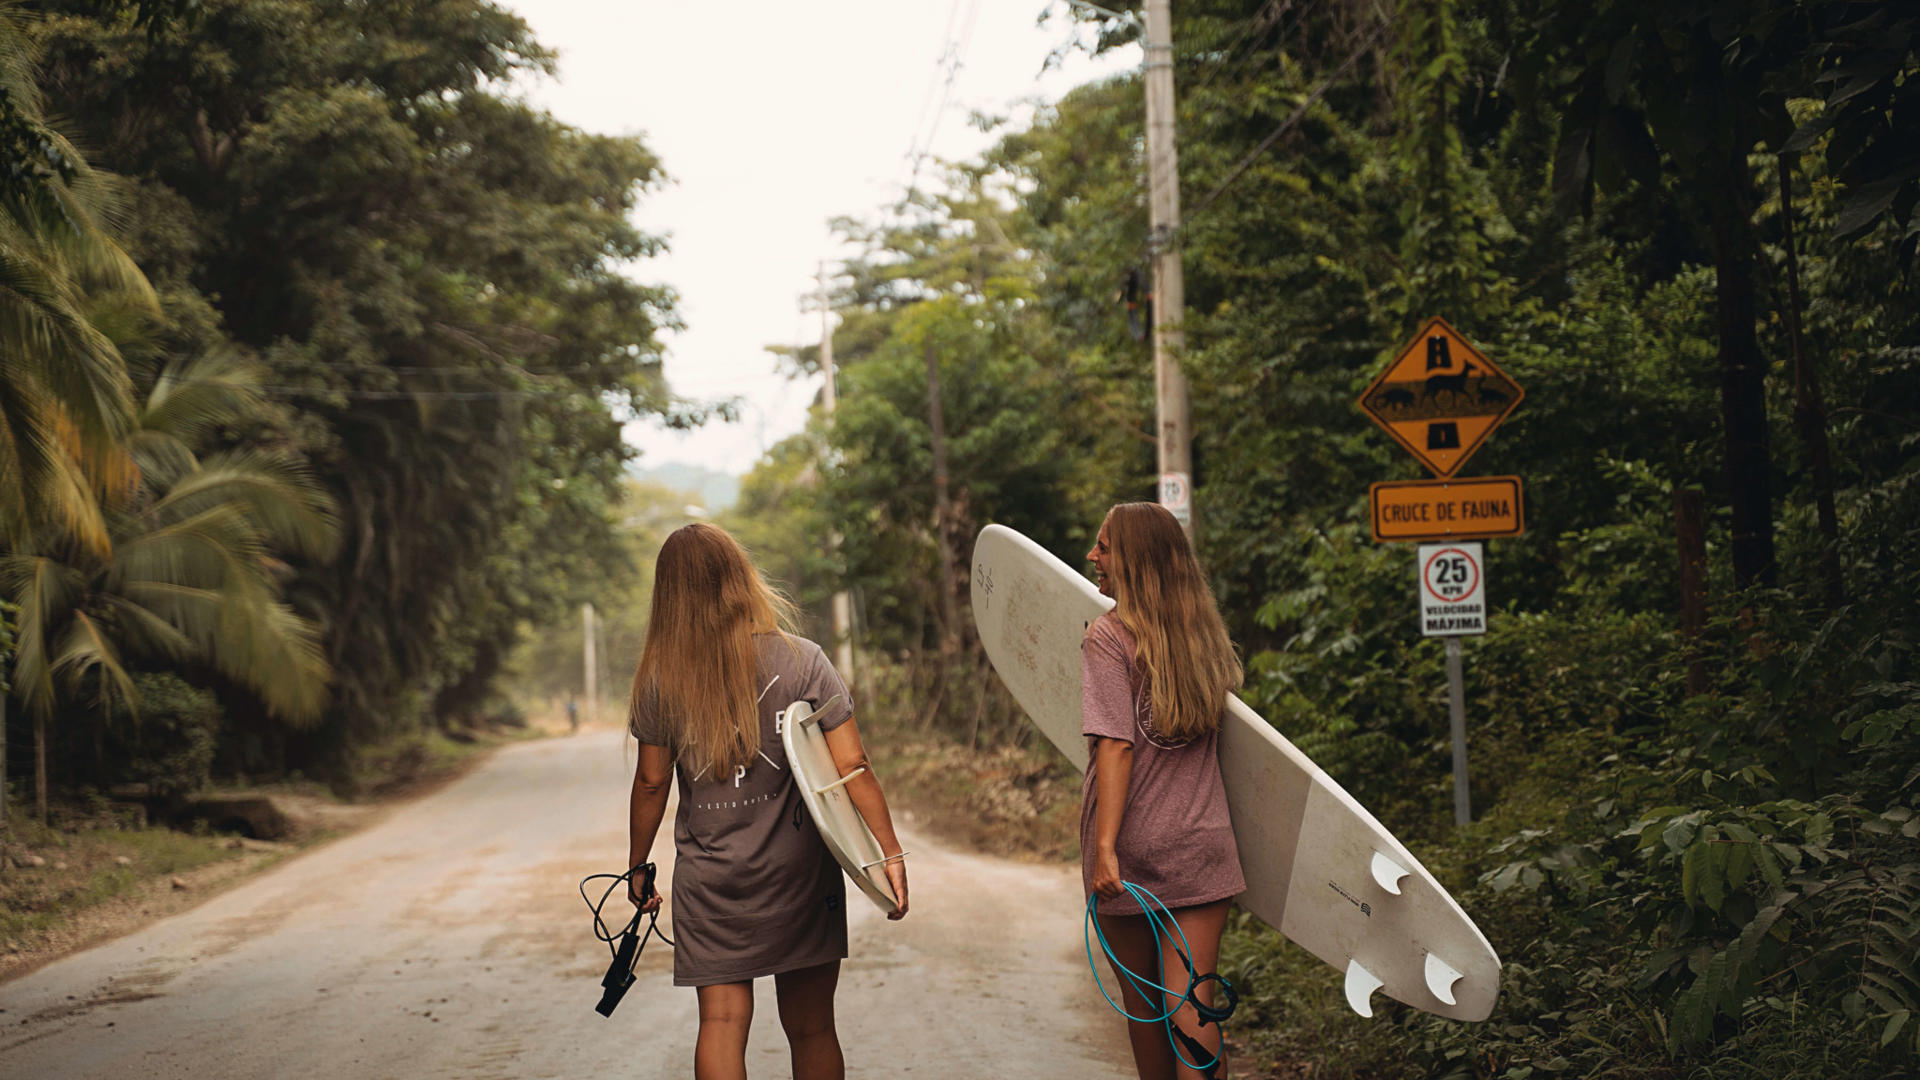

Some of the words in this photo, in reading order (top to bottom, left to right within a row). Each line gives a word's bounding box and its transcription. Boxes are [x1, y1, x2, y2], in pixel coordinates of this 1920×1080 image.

[1382, 503, 1430, 523] CRUCE
[1437, 501, 1456, 521] DE
[1461, 499, 1511, 519] FAUNA
[1435, 557, 1467, 584] 25
[1425, 604, 1482, 614] VELOCIDAD
[734, 765, 746, 788] P
